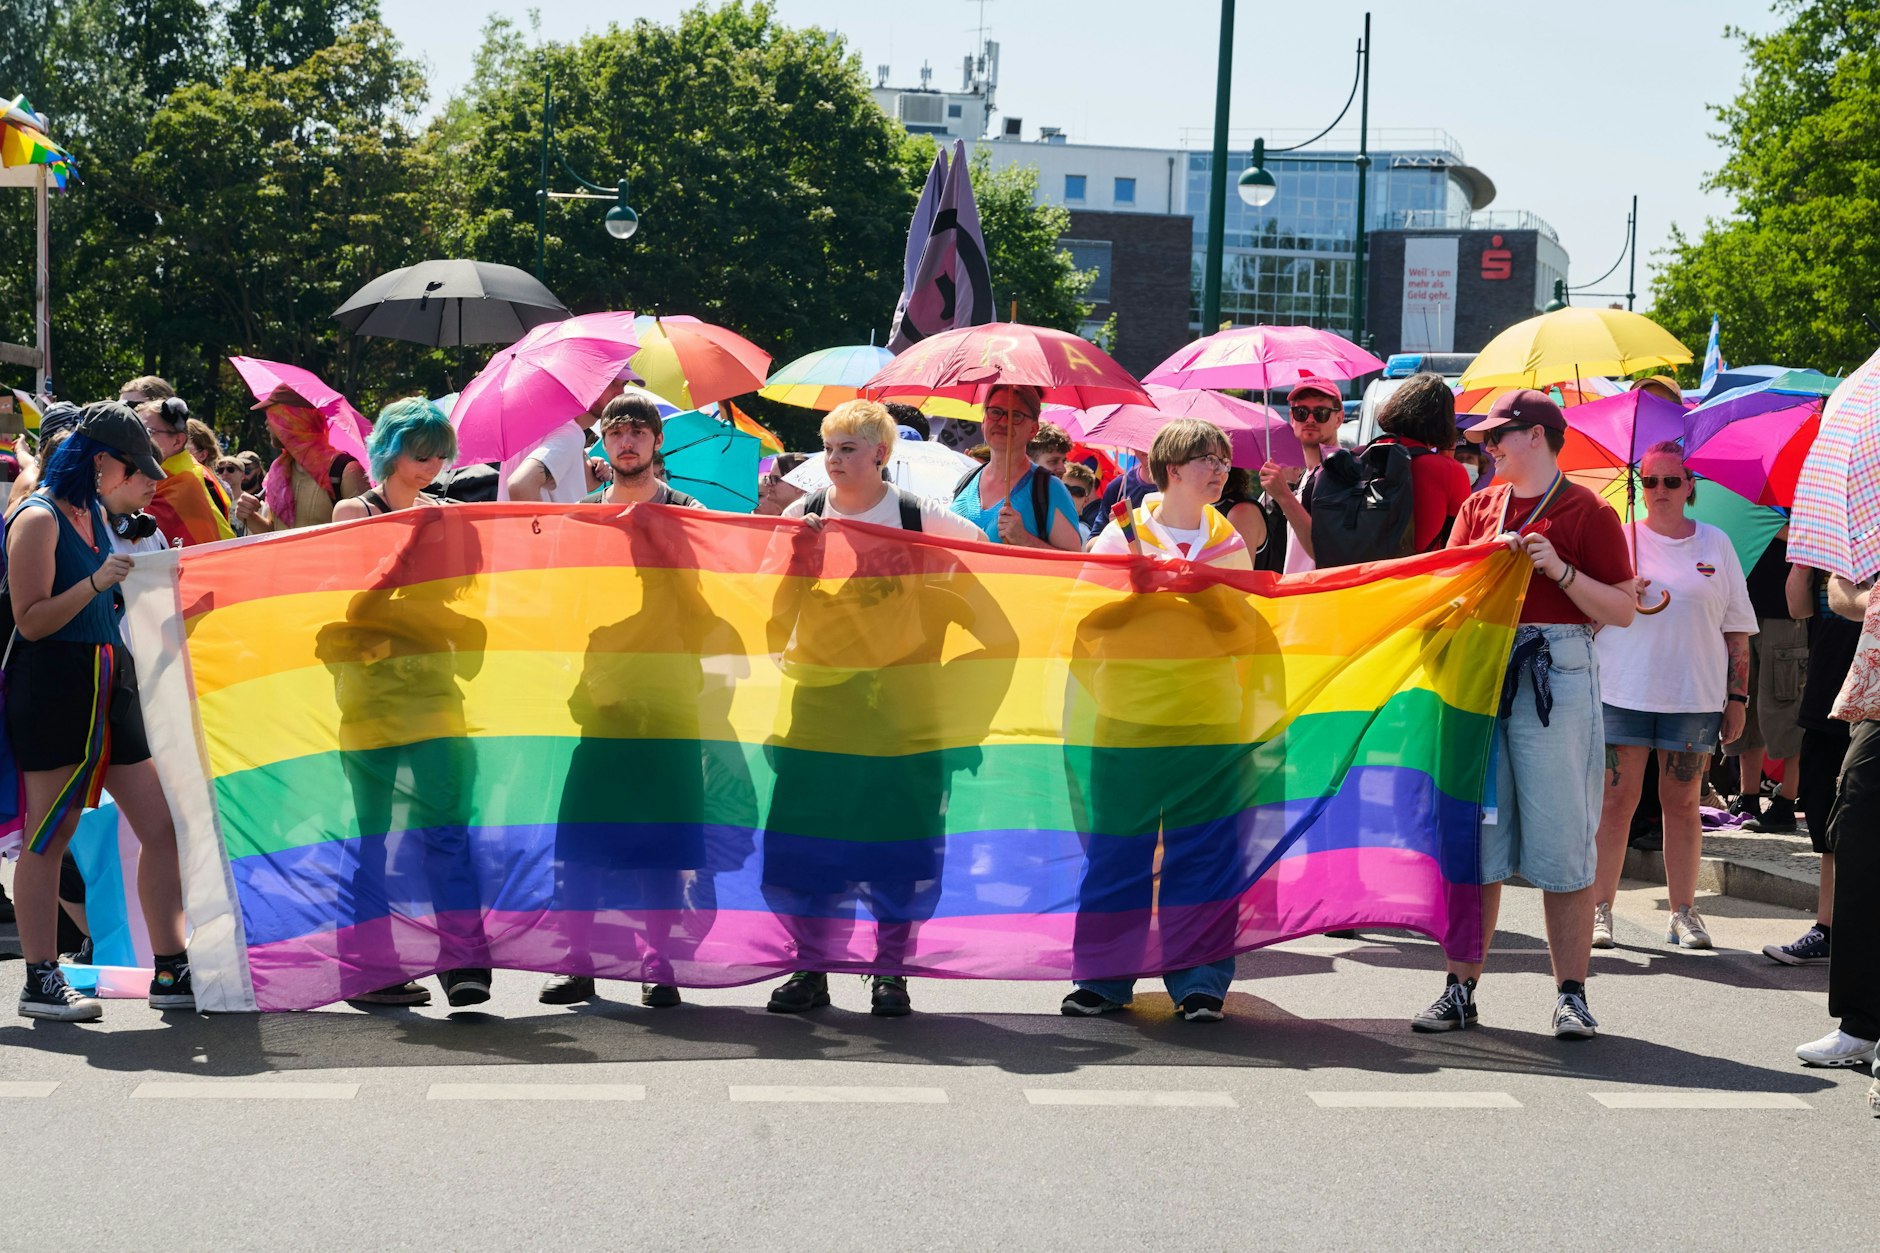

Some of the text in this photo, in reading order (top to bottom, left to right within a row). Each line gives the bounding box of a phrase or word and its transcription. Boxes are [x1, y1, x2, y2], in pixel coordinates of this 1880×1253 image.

[1408, 279, 1444, 288] mehr als
[1407, 290, 1450, 302] Geld geht.
